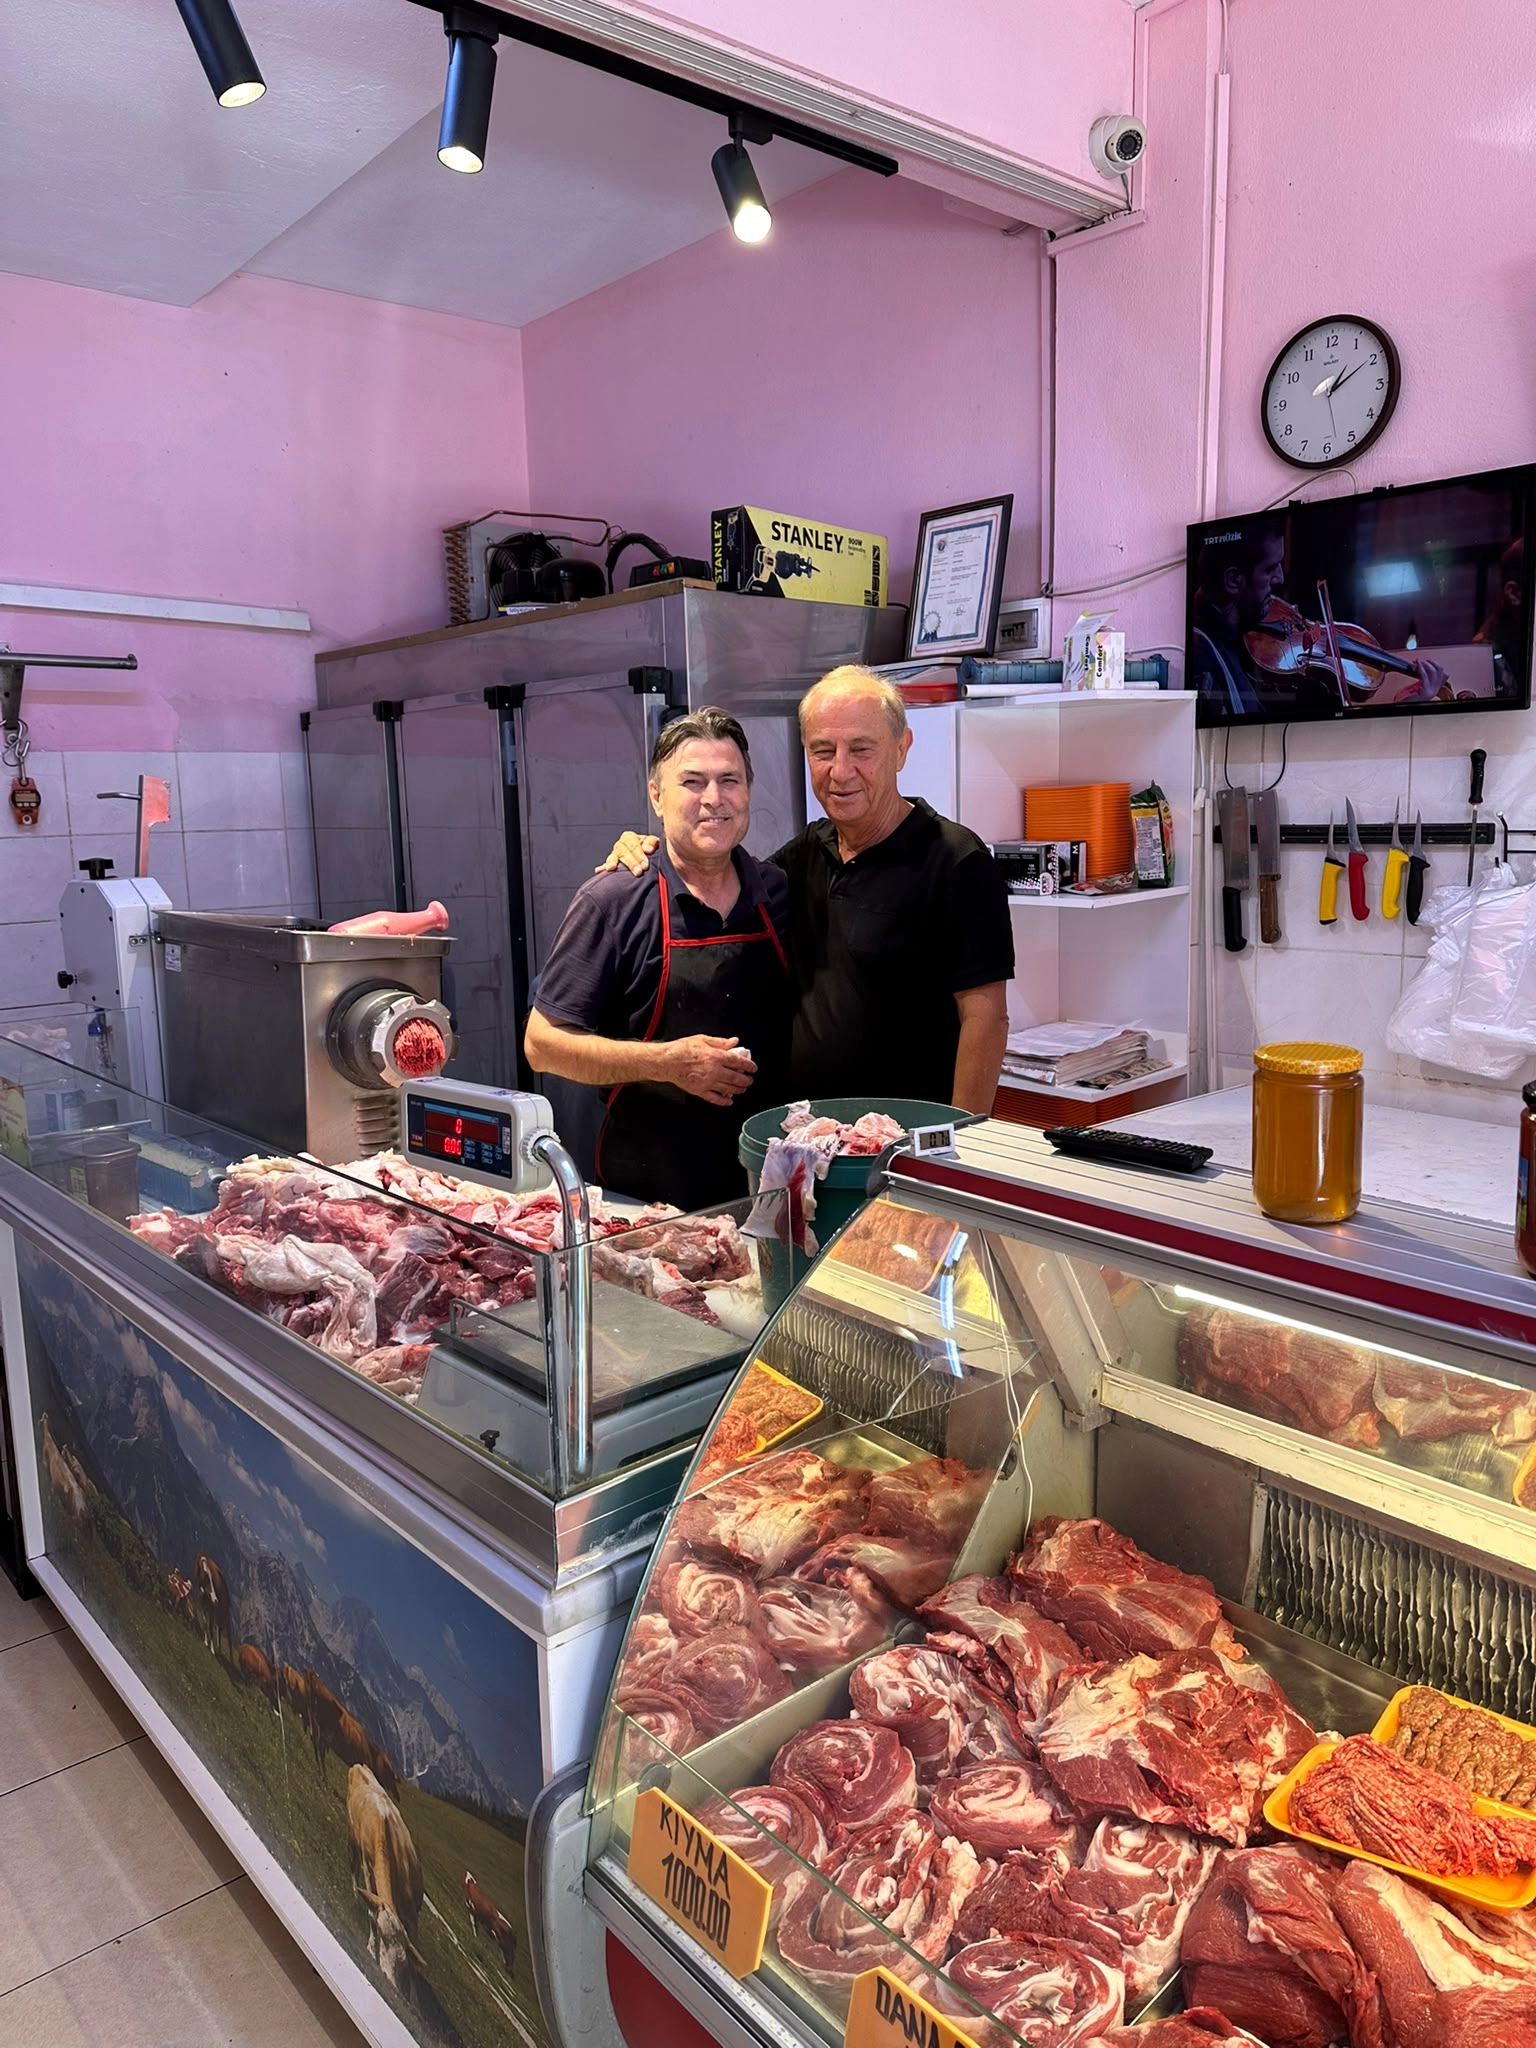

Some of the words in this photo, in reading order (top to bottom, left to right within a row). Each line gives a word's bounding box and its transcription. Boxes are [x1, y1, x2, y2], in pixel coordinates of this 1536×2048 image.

[1326, 335, 1339, 348] 12
[1354, 338, 1359, 350] 1
[1304, 349, 1314, 361] 11
[1369, 353, 1377, 366] 2
[1287, 371, 1300, 384] 10
[1375, 378, 1384, 390] 3
[1278, 400, 1287, 411] 9
[1366, 407, 1375, 419] 4
[1284, 424, 1293, 436] 8
[1347, 430, 1356, 443] 5
[1301, 440, 1309, 451] 7
[1323, 442, 1331, 454] 6
[771, 520, 844, 554] STANLEY
[714, 520, 722, 583] STANLEY
[1072, 844, 1079, 854] M
[455, 1118, 462, 1134] 0
[660, 1801, 731, 1900] KIYMA
[661, 1852, 731, 1952] 1000.00
[875, 1975, 940, 2048] DANA
